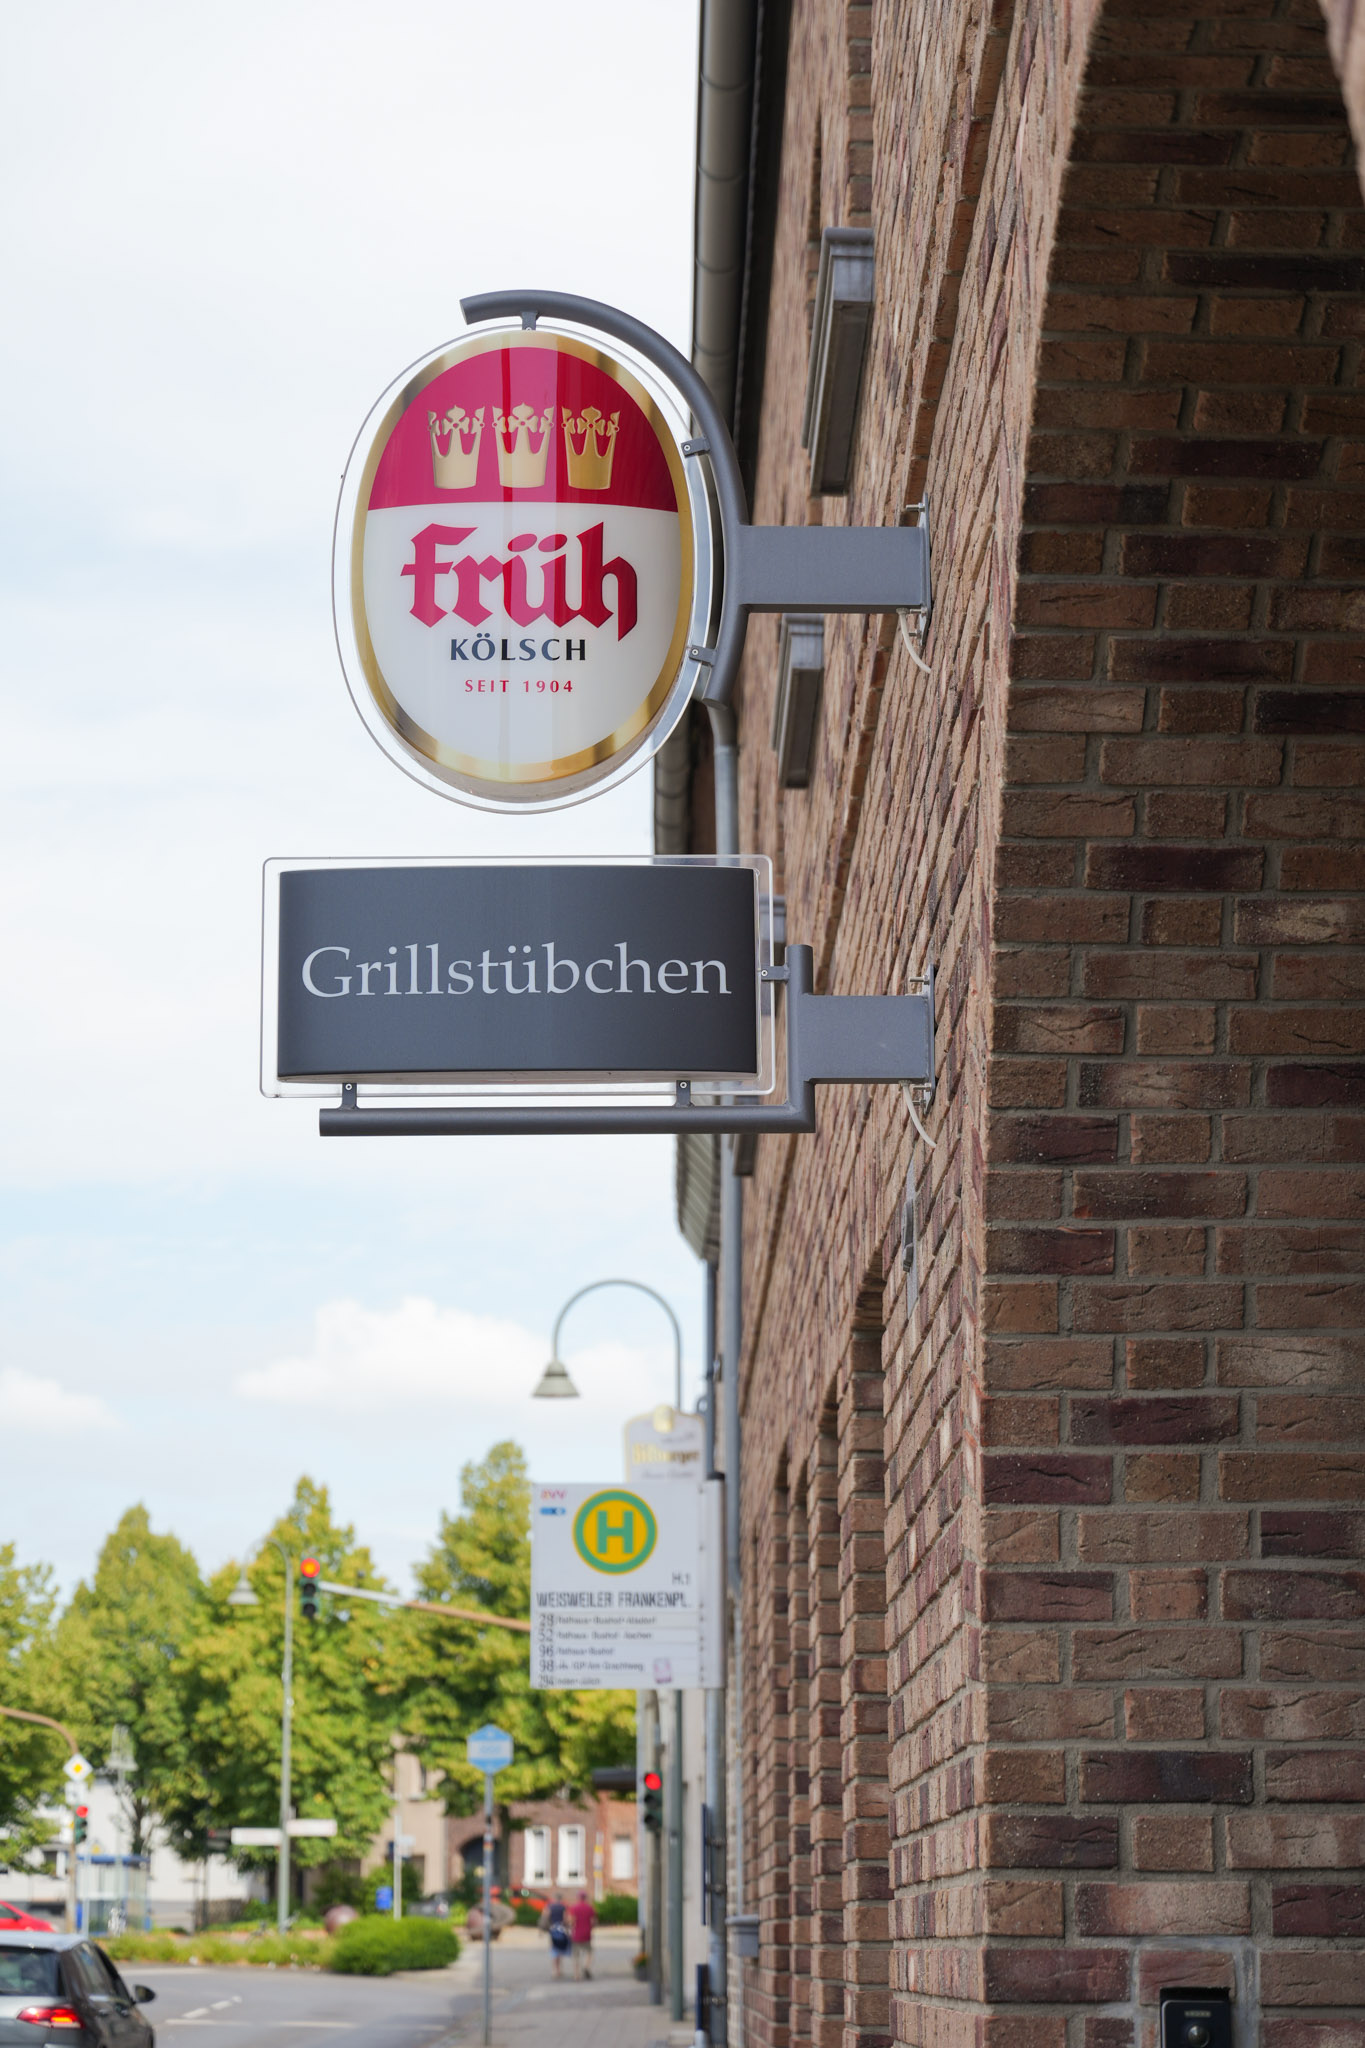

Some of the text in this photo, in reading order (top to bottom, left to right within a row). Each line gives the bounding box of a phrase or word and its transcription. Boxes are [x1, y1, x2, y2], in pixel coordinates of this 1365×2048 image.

[450, 633, 586, 661] KÖLSCH
[464, 679, 574, 693] SEIT 1904
[301, 942, 732, 998] Grillstübchen
[597, 1510, 634, 1554] H
[536, 1592, 692, 1608] WEISWEILER FRANKENPL.
